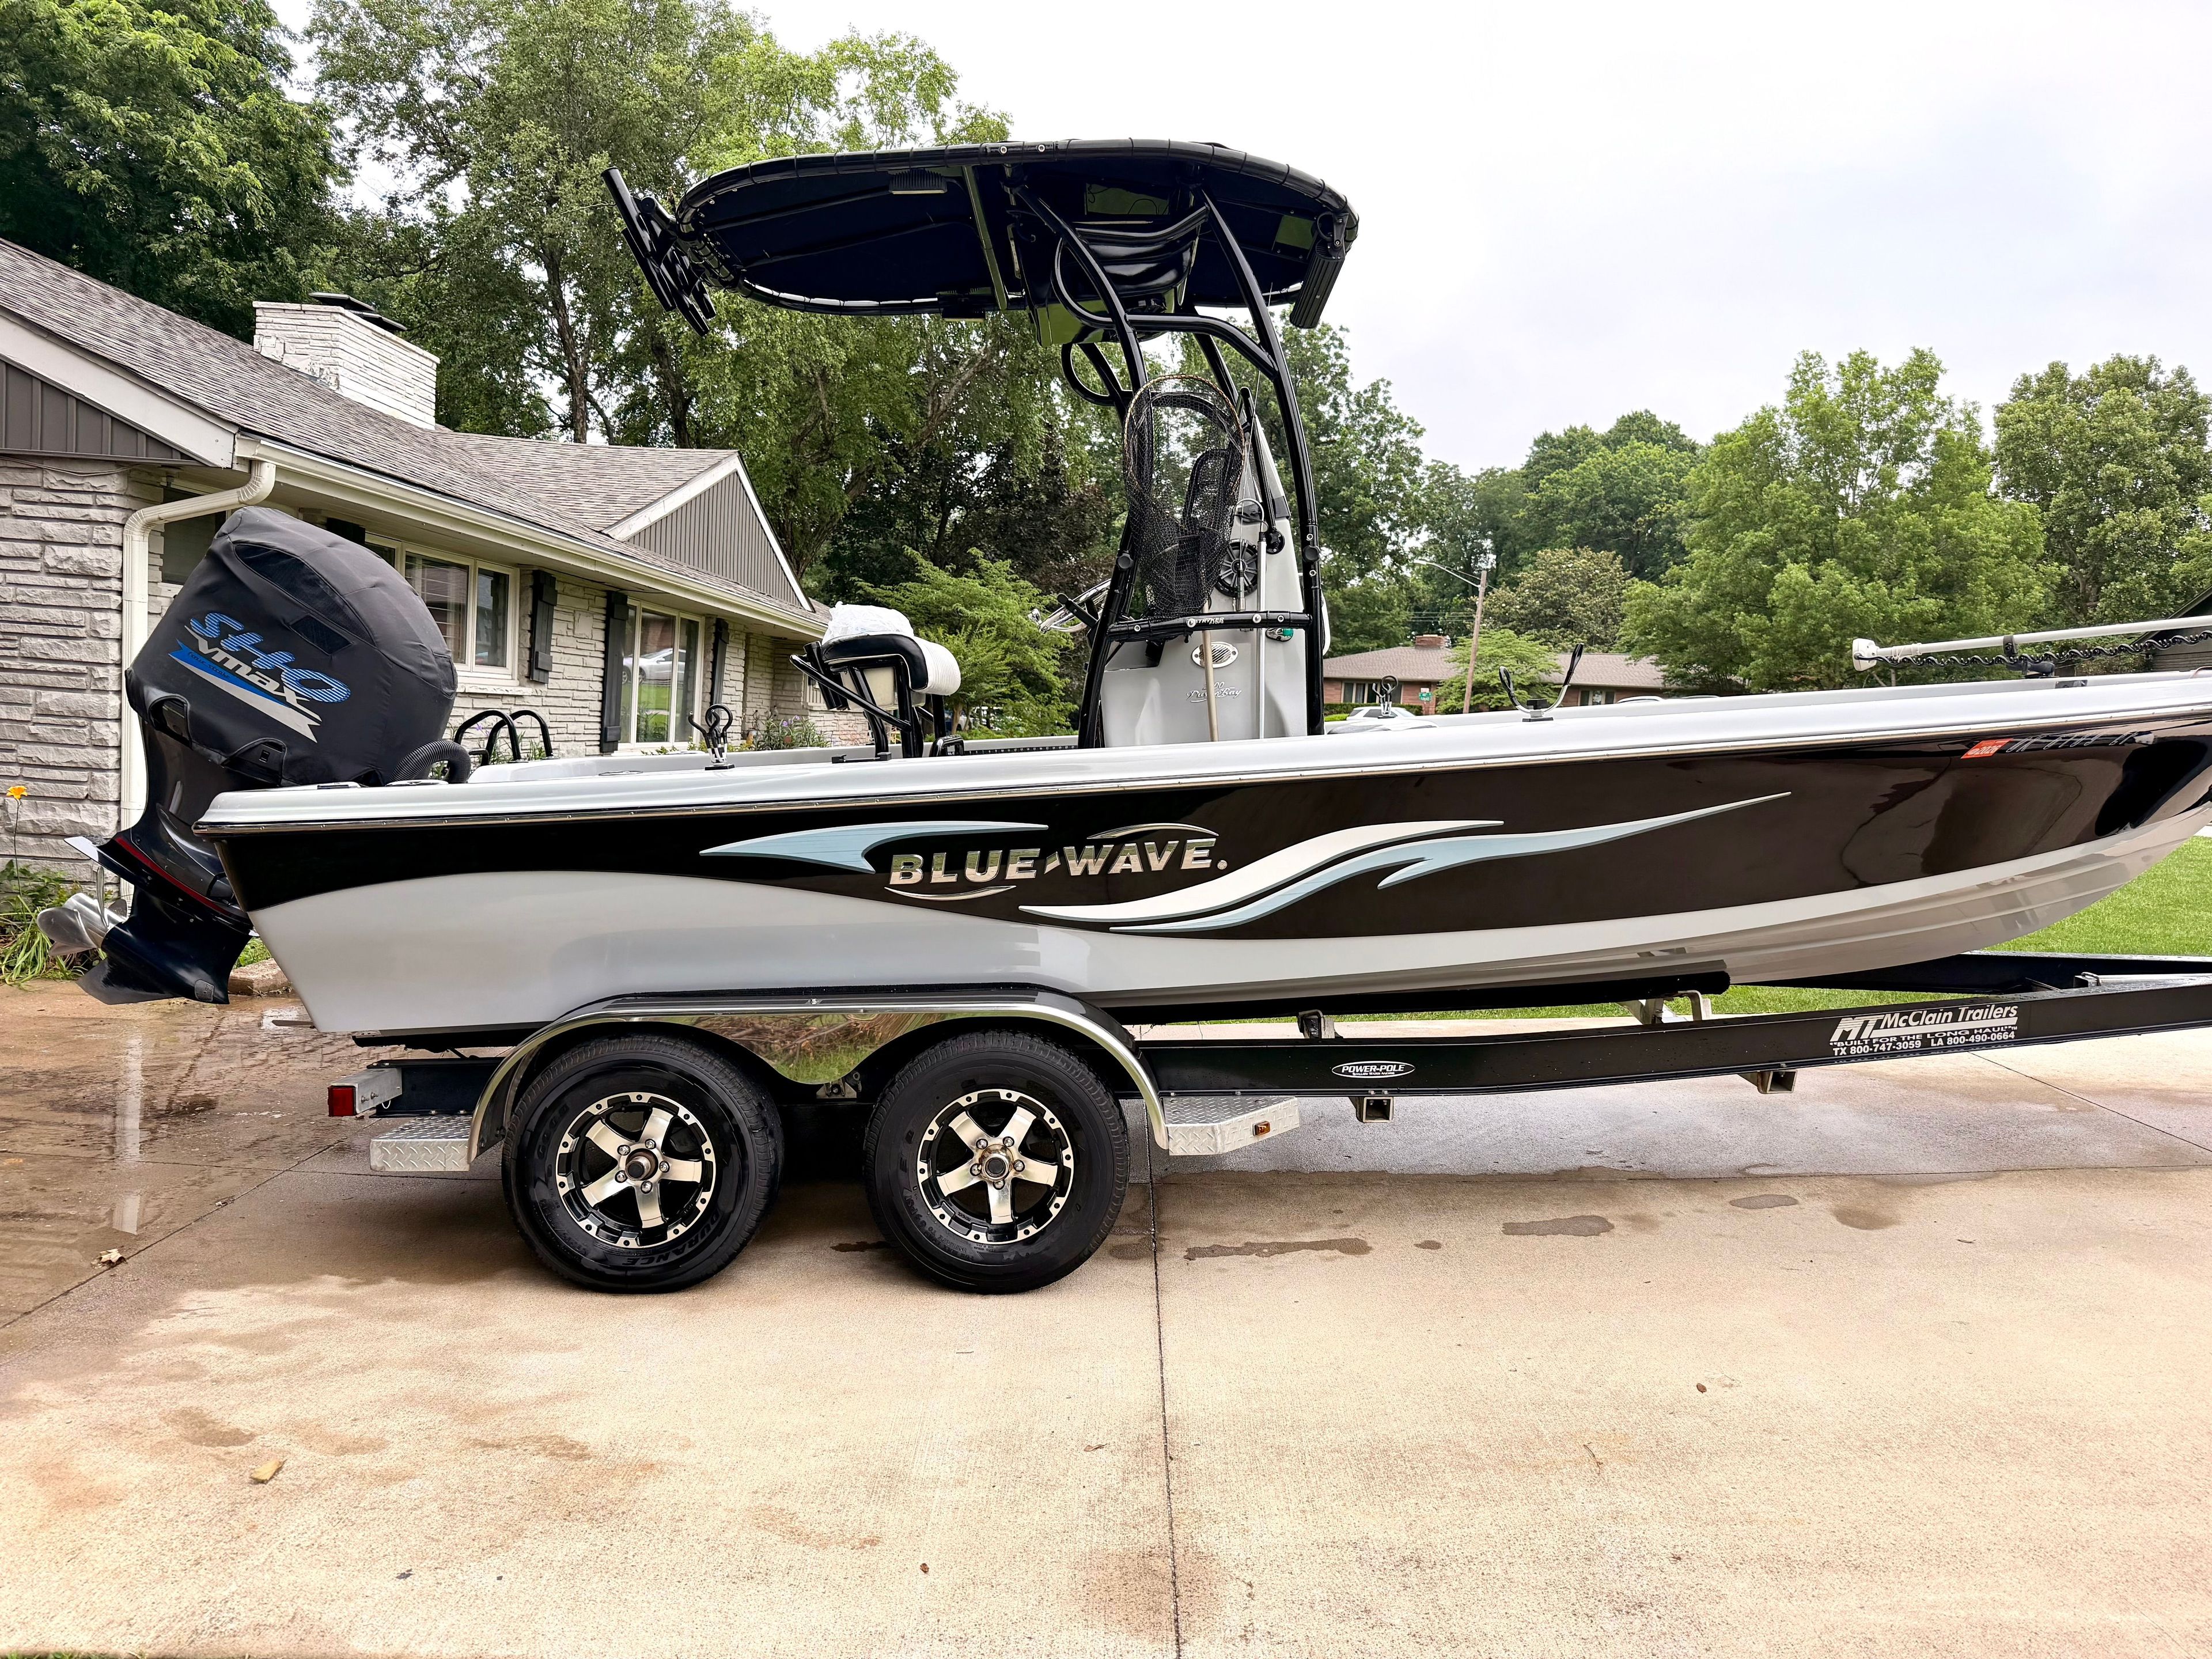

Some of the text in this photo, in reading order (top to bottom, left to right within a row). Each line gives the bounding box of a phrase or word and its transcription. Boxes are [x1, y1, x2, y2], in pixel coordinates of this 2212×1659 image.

[889, 848, 1040, 885] BLUE
[1830, 1014, 1886, 1041] MT
[1880, 1005, 2018, 1028] McClain Trailers
[1833, 1031, 2015, 1055] TX 800-747-3059 LA 800-490-0664
[1927, 1030, 1969, 1039] LONG
[1342, 1065, 1406, 1073] POWER-POLE
